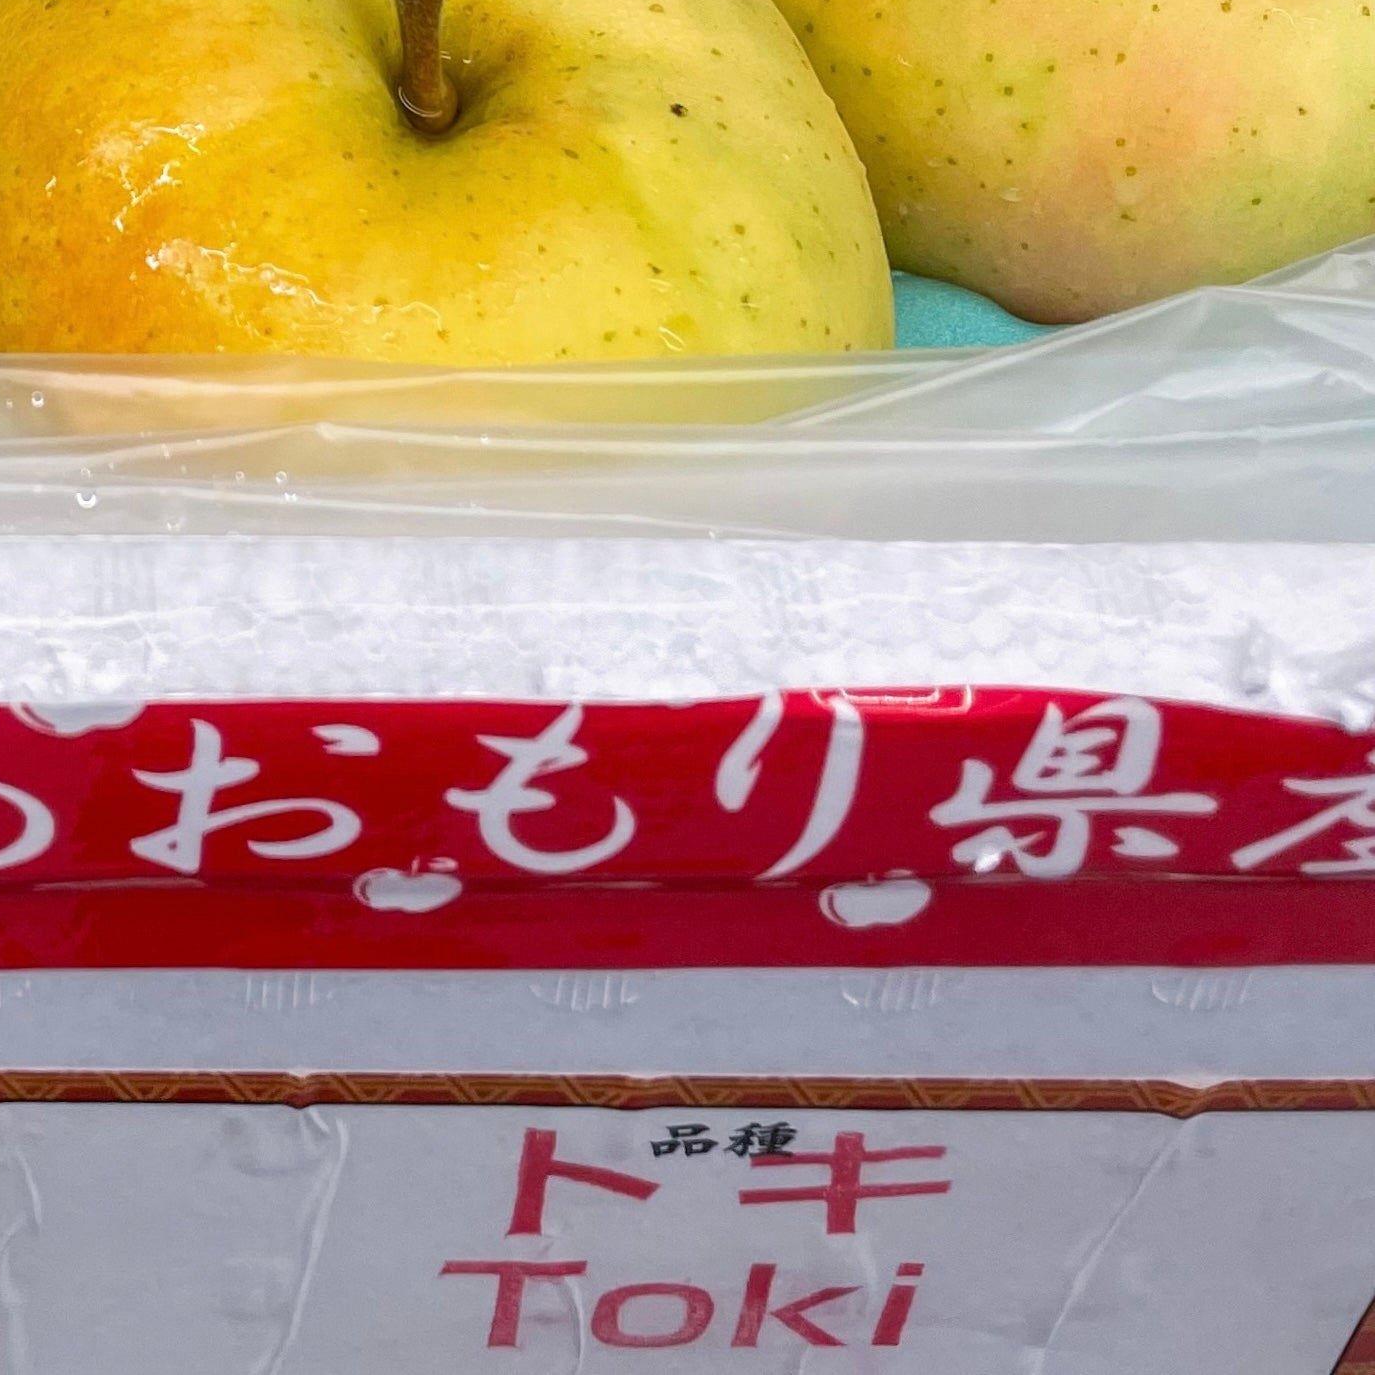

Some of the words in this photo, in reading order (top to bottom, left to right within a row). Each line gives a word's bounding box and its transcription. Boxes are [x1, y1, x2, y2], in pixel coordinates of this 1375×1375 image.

[504, 1127, 952, 1236] トキ
[649, 1122, 796, 1157] 品種
[438, 1259, 925, 1348] Toki
